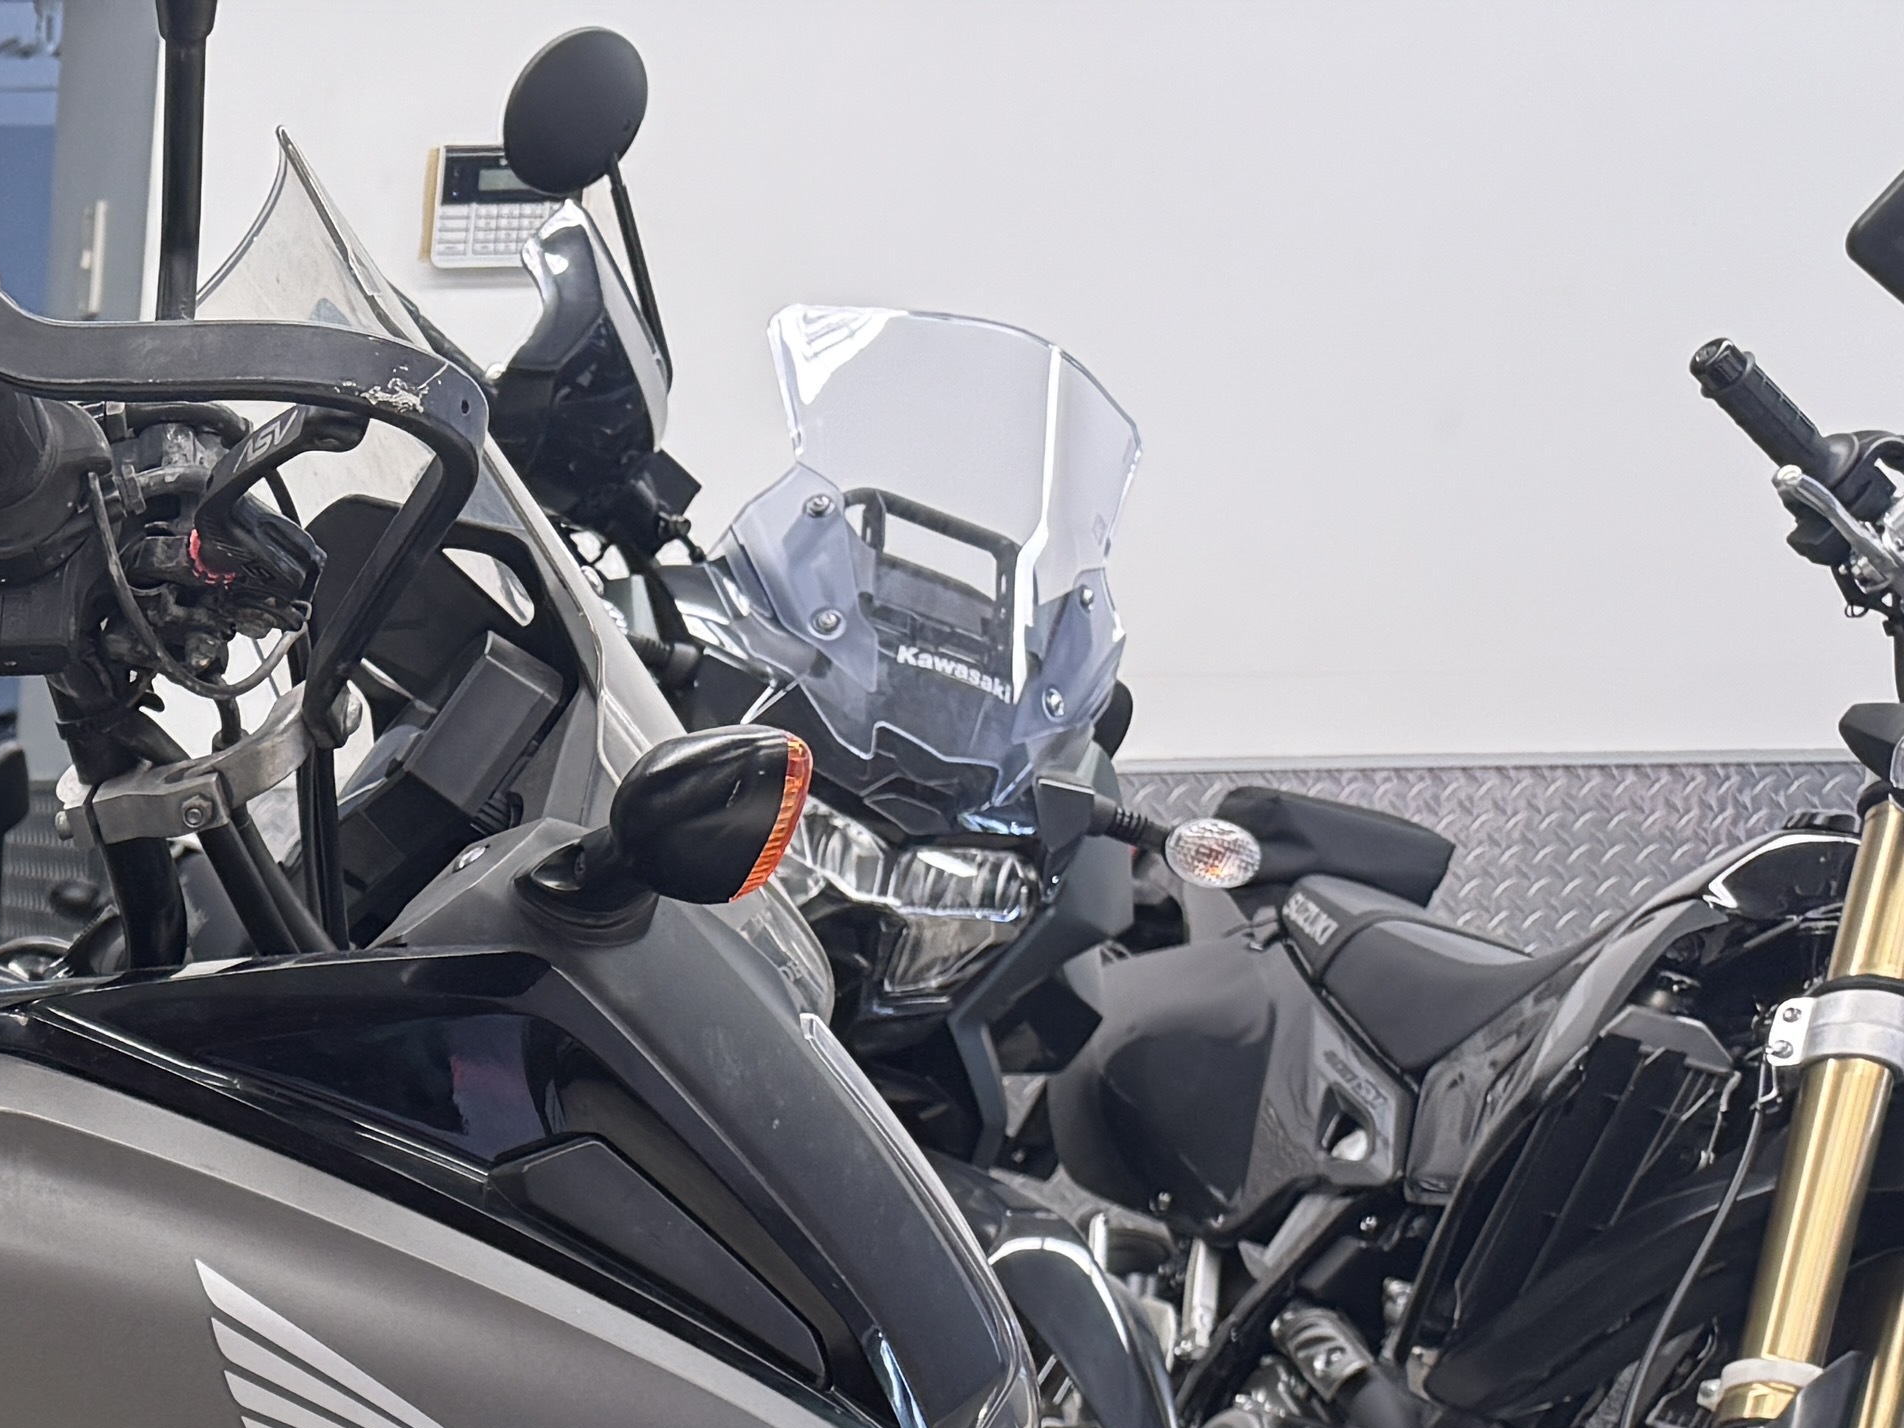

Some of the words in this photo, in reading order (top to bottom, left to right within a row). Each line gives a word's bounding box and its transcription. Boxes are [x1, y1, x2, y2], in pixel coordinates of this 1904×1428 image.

[232, 408, 299, 474] ASV
[896, 644, 1012, 705] Kawasaki
[1282, 892, 1339, 946] SUZUKI
